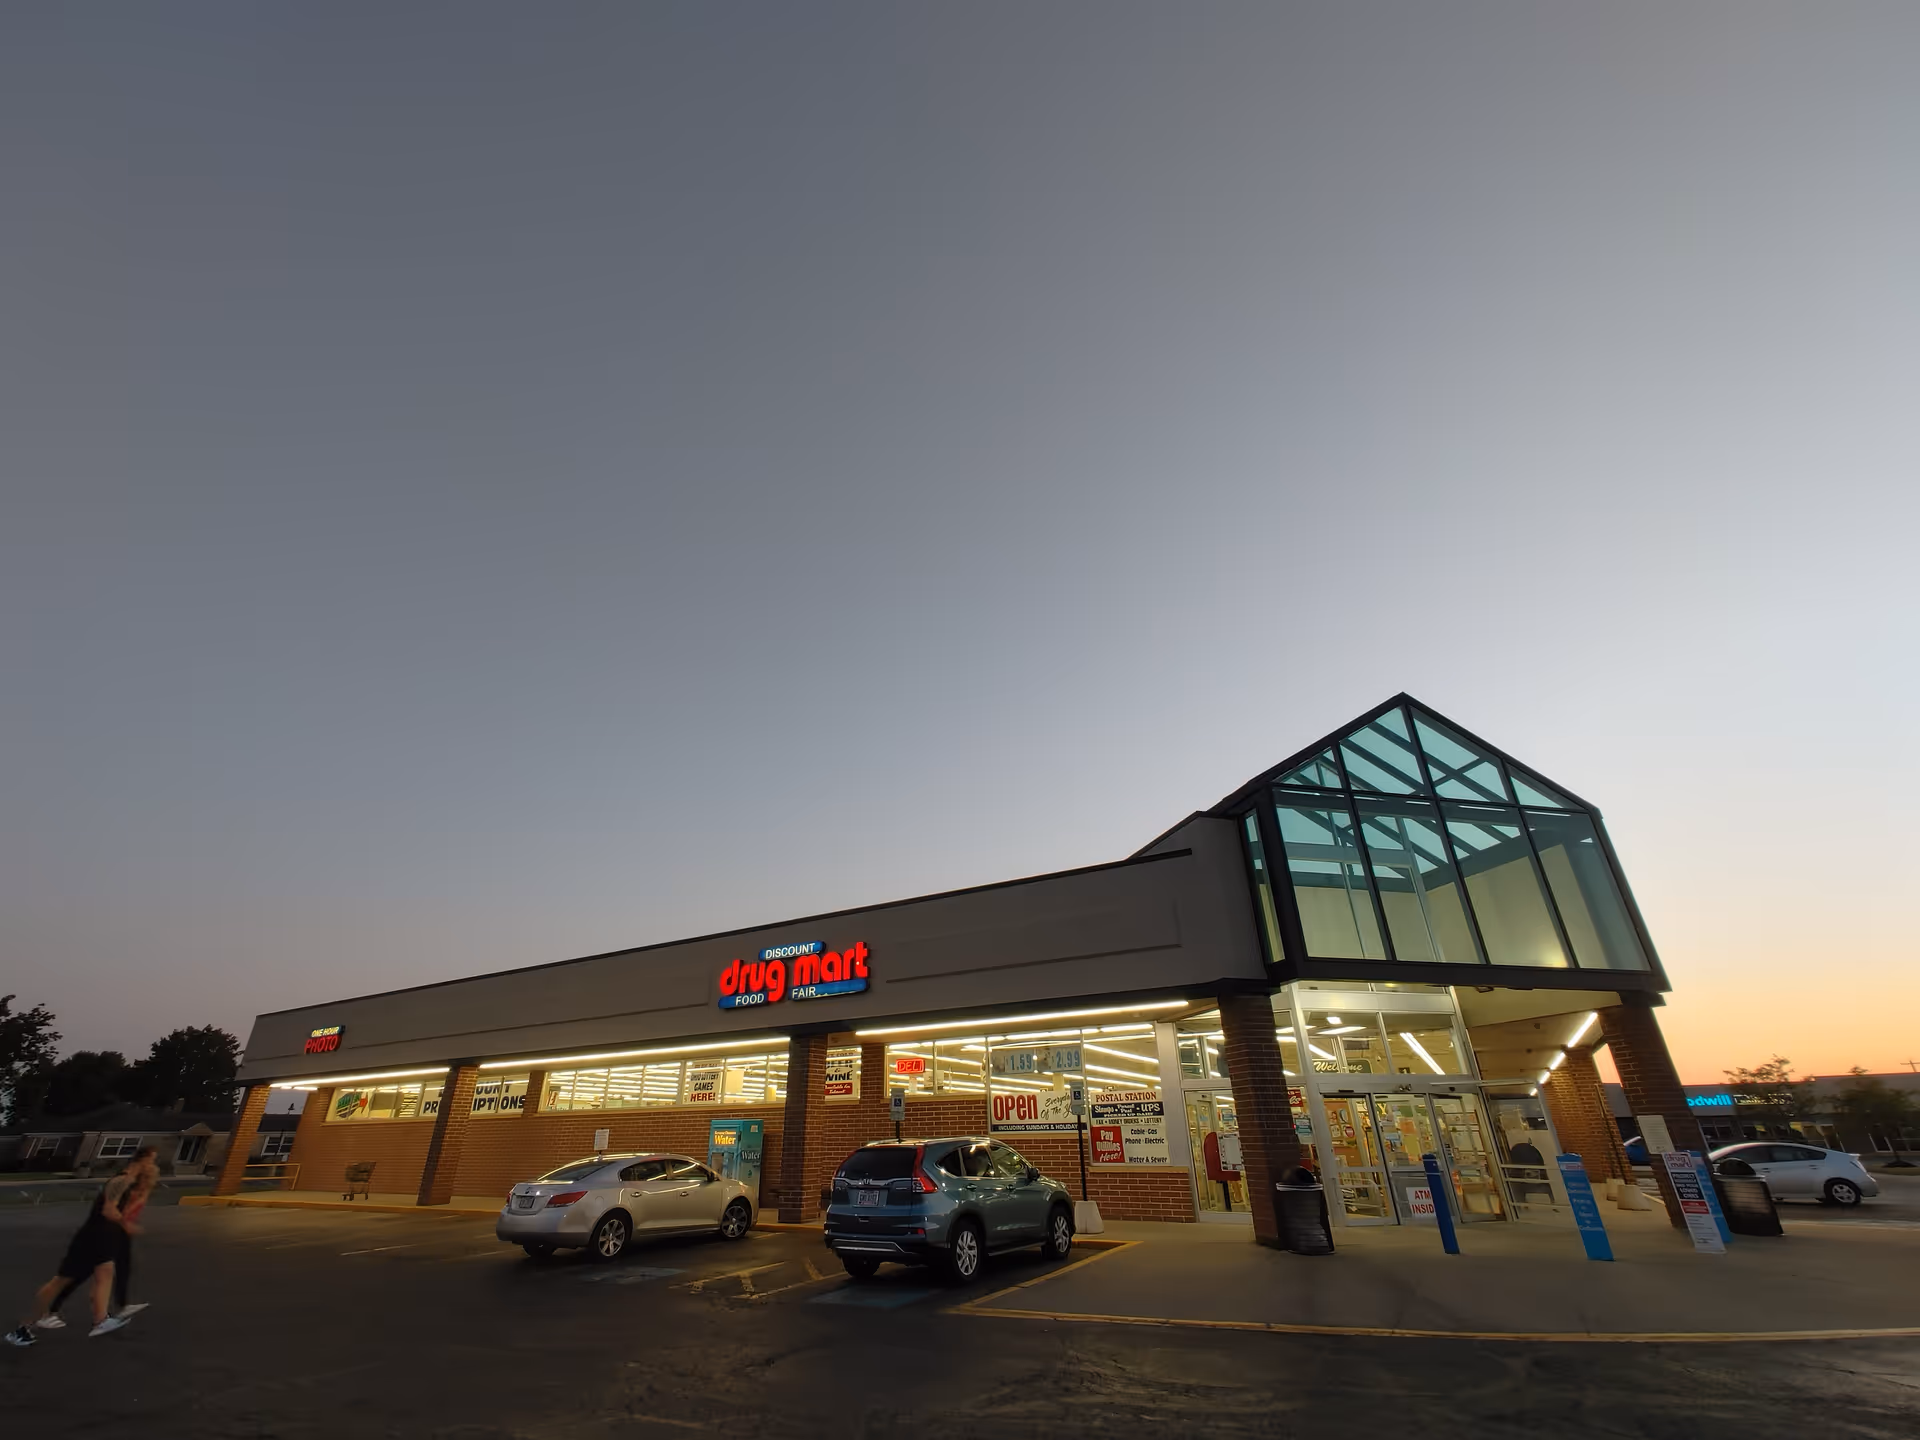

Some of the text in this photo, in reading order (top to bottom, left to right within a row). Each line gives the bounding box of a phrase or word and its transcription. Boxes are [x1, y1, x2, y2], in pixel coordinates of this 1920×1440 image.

[765, 943, 816, 959] DISCOUNT
[720, 941, 868, 1002] drug mart
[735, 986, 816, 1006] FOOD FAIR
[311, 1027, 339, 1037] ONE HOUR
[304, 1035, 338, 1054] PHOTO
[1056, 1049, 1080, 1068] 2.99
[899, 1061, 922, 1072] DELI
[826, 1070, 853, 1081] WINE
[694, 1082, 714, 1091] GAMES
[690, 1092, 716, 1102] HERE!
[1096, 1092, 1156, 1102] POSTAL STATION
[1051, 1106, 1061, 1115] The
[1141, 1103, 1160, 1112] UPS
[714, 1134, 737, 1145] Water
[1100, 1130, 1114, 1141] Pay
[741, 1150, 761, 1160] Water
[1150, 1156, 1168, 1164] Sewer
[1414, 1190, 1431, 1200] ATM
[1411, 1204, 1434, 1214] INSID
